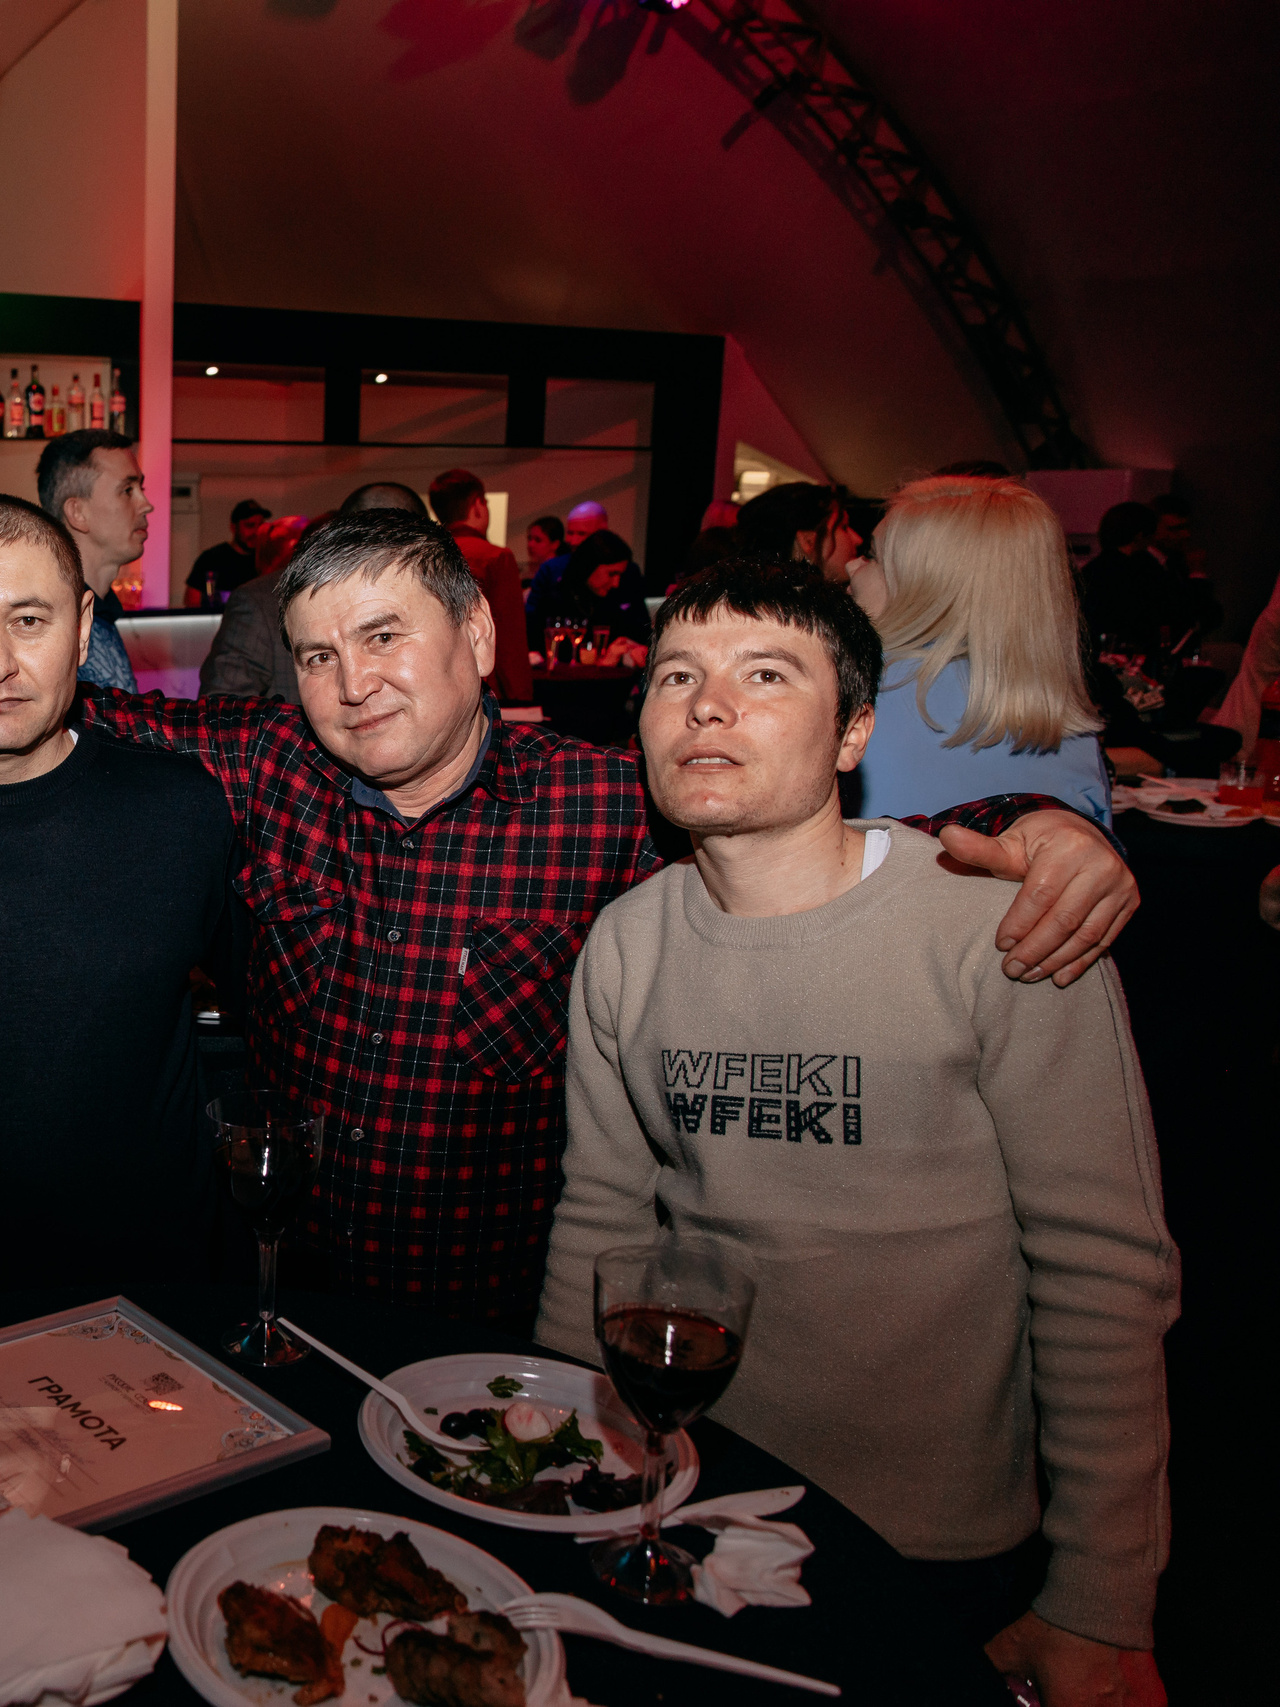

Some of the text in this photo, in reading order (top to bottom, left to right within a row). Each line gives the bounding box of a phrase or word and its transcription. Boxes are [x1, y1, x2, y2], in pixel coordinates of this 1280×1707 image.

[661, 1049, 861, 1098] WFEKI
[664, 1092, 862, 1145] WFEKI
[27, 1375, 127, 1451] ГРАМОТА
